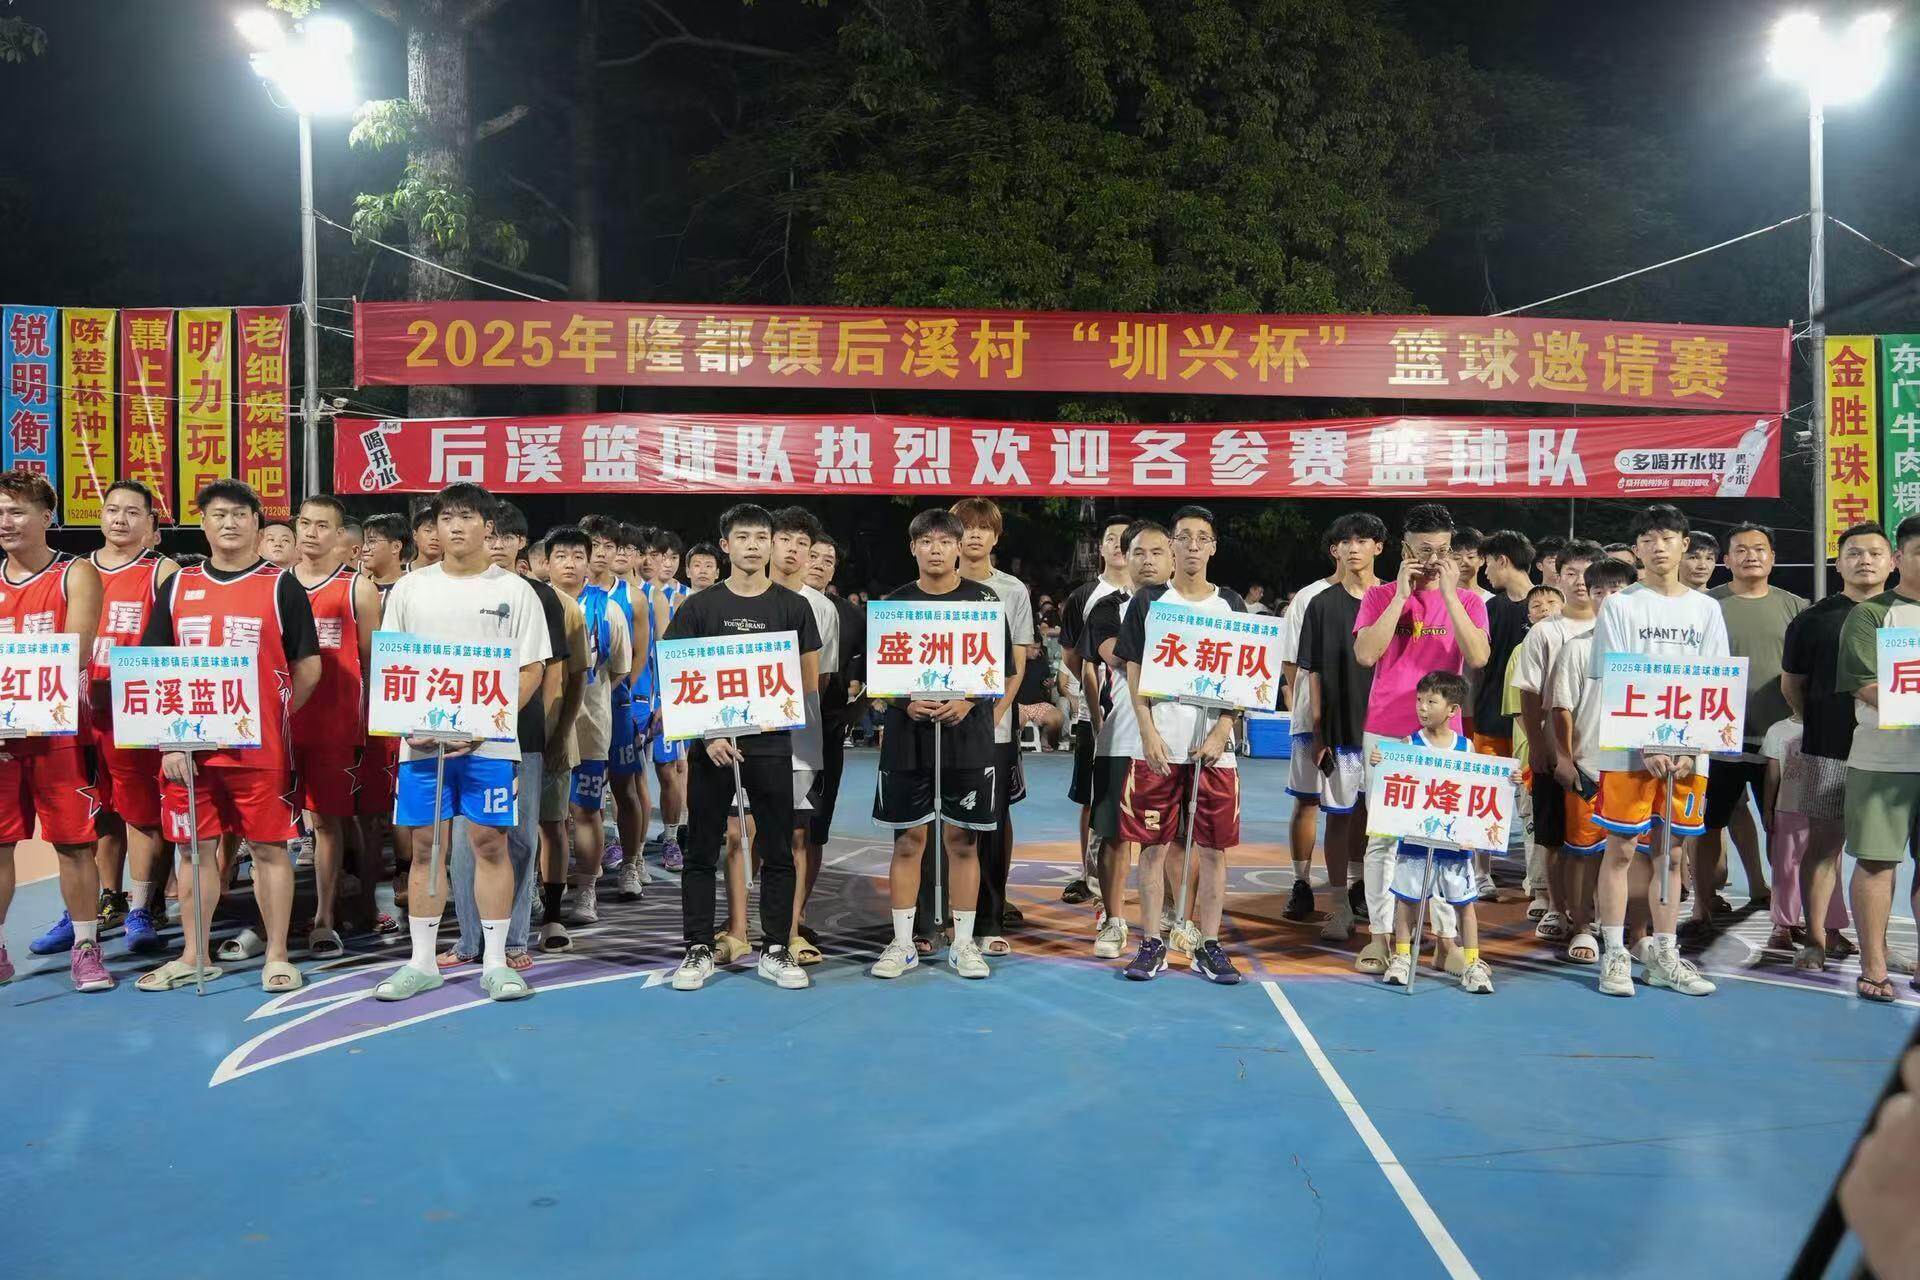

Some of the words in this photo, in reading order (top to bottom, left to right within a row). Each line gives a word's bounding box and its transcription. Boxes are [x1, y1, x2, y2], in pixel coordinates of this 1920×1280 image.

[70, 317, 108, 501] 陈楚林种子店
[1828, 345, 1870, 533] 金胜珠宝
[1890, 342, 1920, 540] 东门牛肉粿
[363, 431, 398, 487] 喝开水
[429, 423, 1588, 487] 后溪篮球队热烈欢迎各参赛篮球队
[1633, 452, 1726, 470] 多喝开水好
[68, 508, 102, 519] 15220442
[874, 610, 998, 621] 2025年隆都镇后溪篮球邀请赛
[1155, 611, 1280, 637] 2025年隆都镇后溪篮球邀请赛
[379, 642, 512, 658] 2025年隆都镇后溪篮球邀请赛
[664, 640, 792, 660] 2025年隆都镇后溪篮球邀请赛
[877, 631, 997, 666] 盛洲队
[1153, 633, 1272, 681] 永新队
[1885, 638, 1920, 649] 2025年
[118, 656, 250, 668] 2025年隆都镇后溪篮球邀请赛
[1611, 663, 1741, 677] 2025年隆都镇后溪篮球邀请赛
[1889, 658, 1920, 695] 后
[0, 665, 69, 702] 红队
[122, 678, 252, 716] 后溪蓝队
[381, 664, 510, 707] 前沟队
[670, 662, 795, 706] 龙田队
[1611, 684, 1736, 722] 上北队
[1383, 751, 1511, 778] 2025年隆都镇后溪篮球邀请赛
[483, 787, 509, 814] 12
[576, 773, 603, 798] 23
[960, 790, 977, 810] 4
[1383, 773, 1504, 822] 前烽队
[1144, 809, 1161, 830] 2
